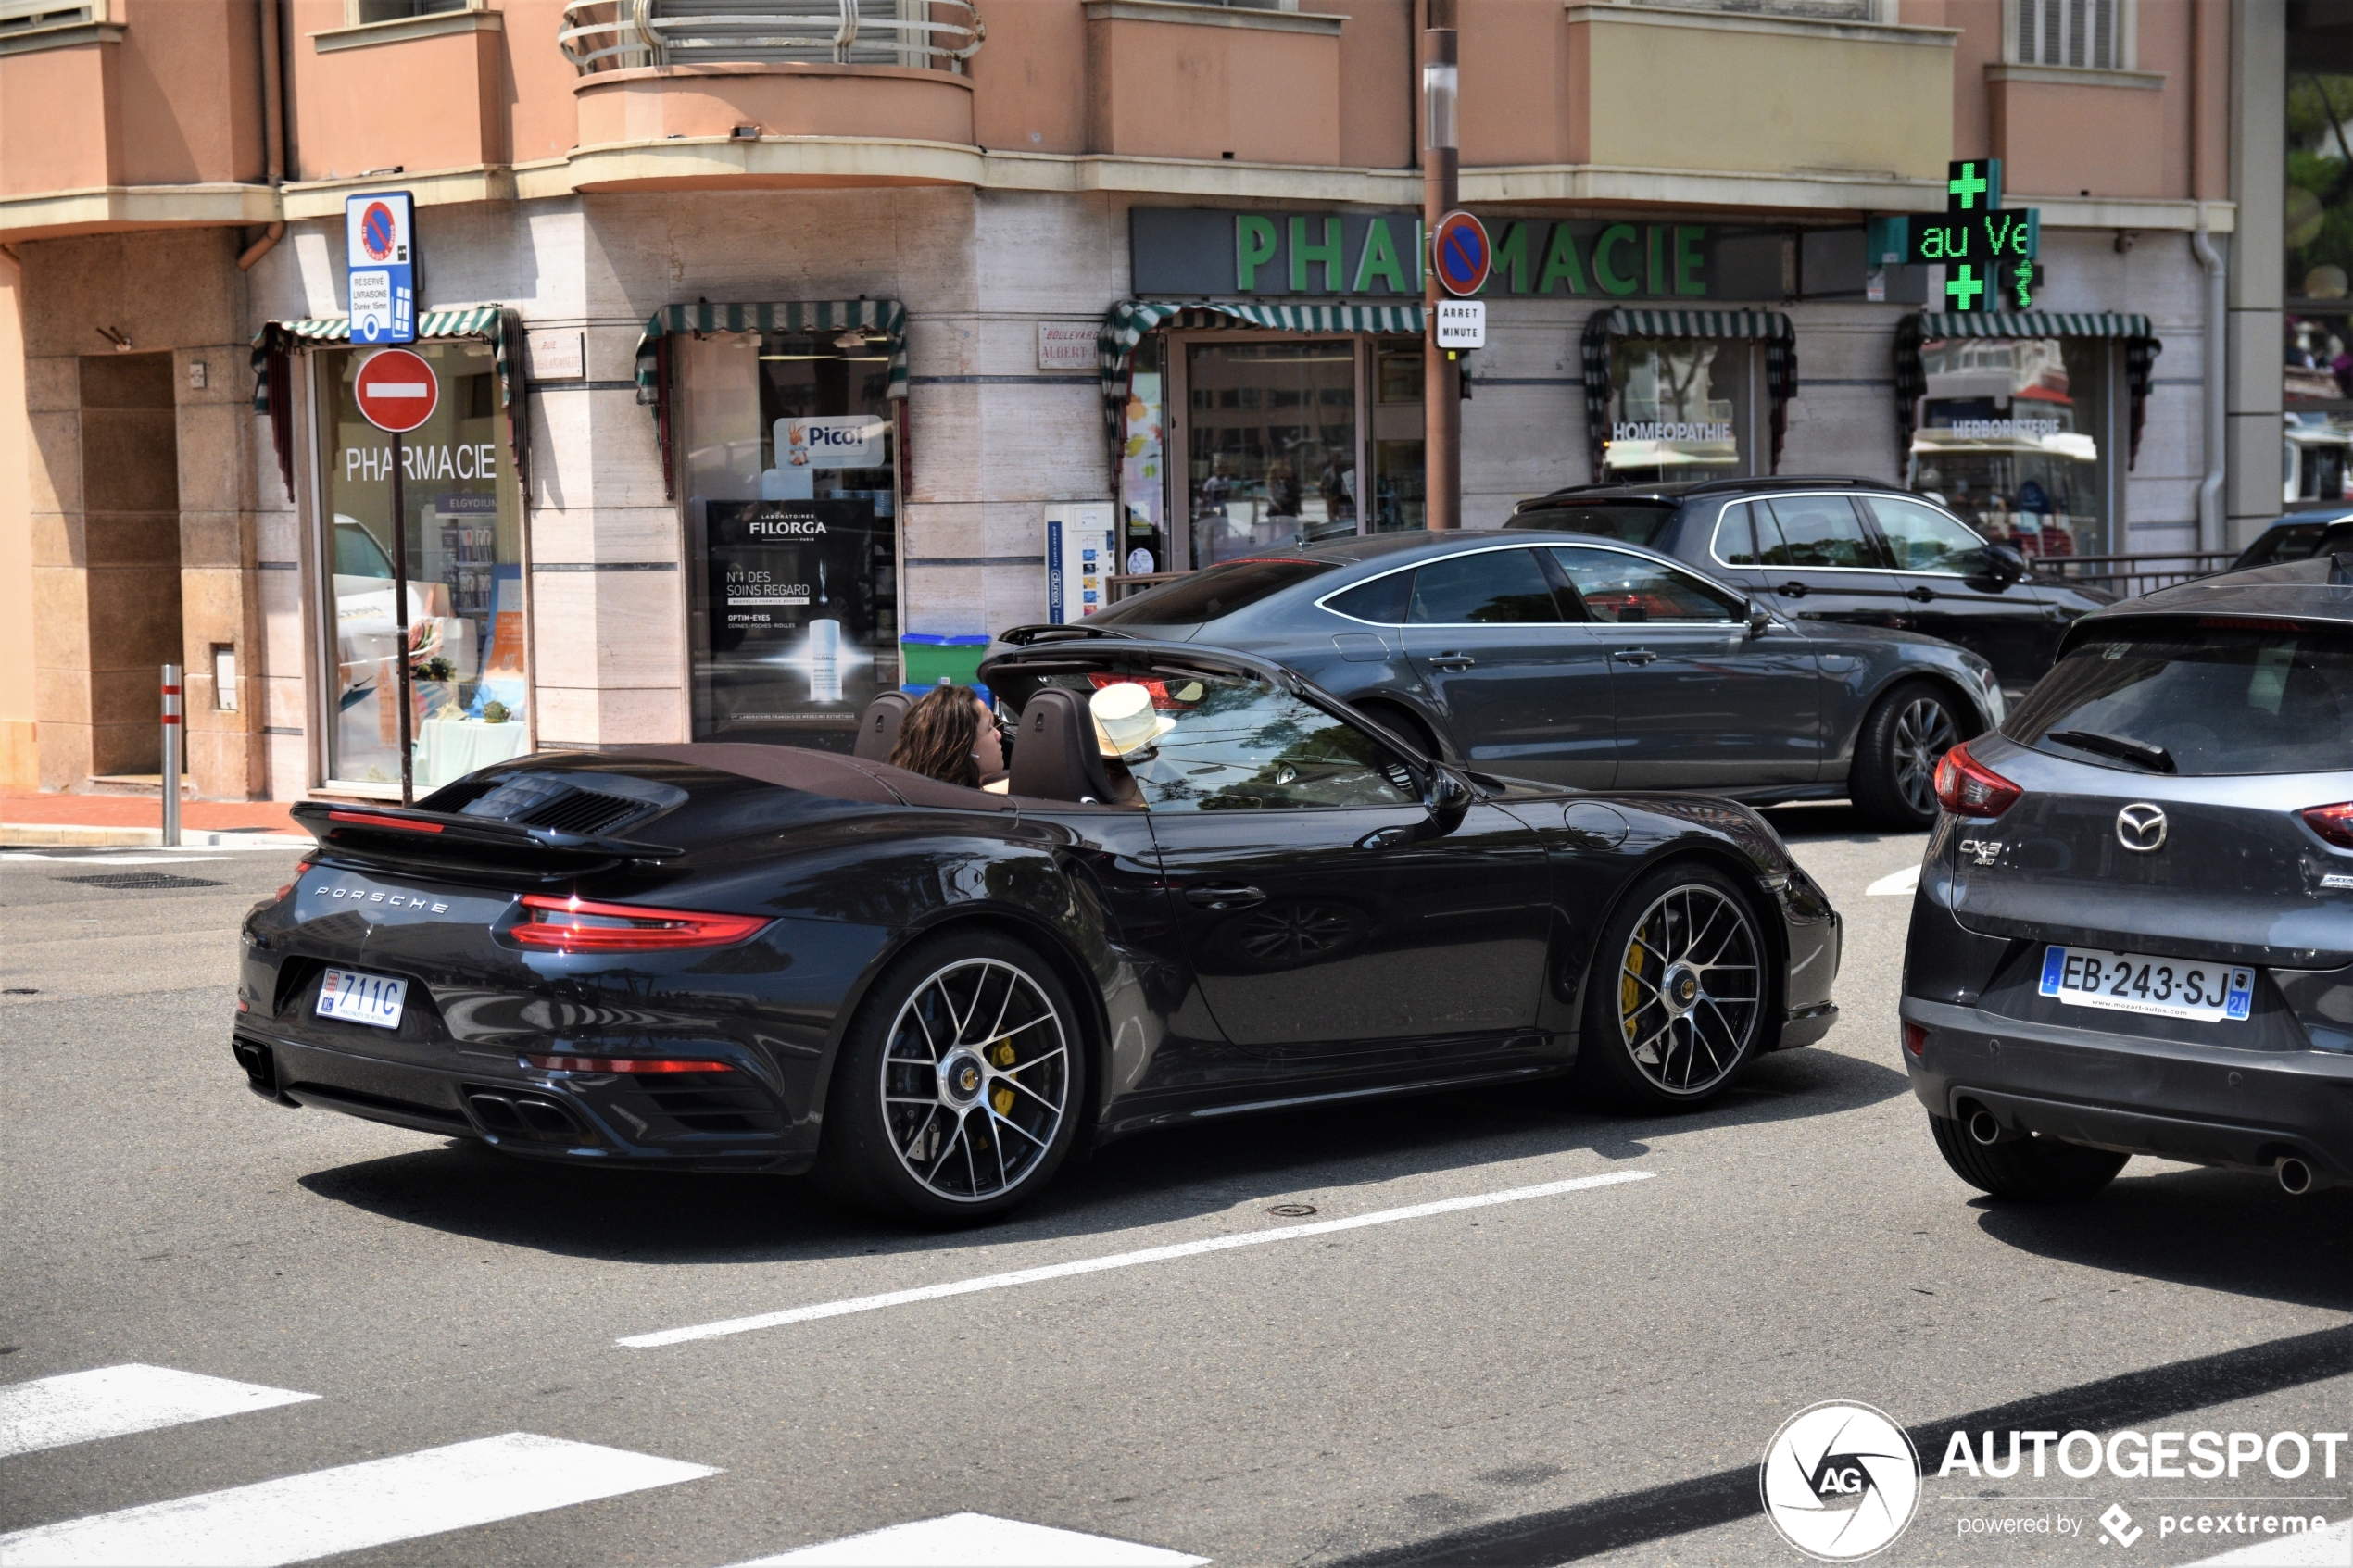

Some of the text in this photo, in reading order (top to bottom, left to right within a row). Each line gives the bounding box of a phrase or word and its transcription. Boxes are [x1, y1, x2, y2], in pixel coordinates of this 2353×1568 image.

[1920, 227, 1968, 257] au
[1236, 214, 1706, 295] PHAMACIE
[353, 290, 388, 299] LIVRAISONS
[1442, 308, 1478, 318] ARRET
[1047, 330, 1100, 340] BOULEVARD
[1442, 328, 1478, 337] MINUTE
[542, 341, 557, 350] RUE
[1041, 346, 1087, 358] ALBERT
[809, 426, 864, 446] Picot
[1613, 421, 1730, 441] HOMEOPATHIE
[1952, 419, 2060, 439] HERBORISTERIE
[346, 445, 497, 482] PHARMACIE
[749, 521, 827, 534] FILORGA
[748, 571, 772, 583] DES
[726, 584, 810, 596] SOINS REGARD
[1959, 839, 2003, 857] CX-3
[1973, 857, 1995, 866] AWD
[315, 886, 449, 914] PORSCHE
[2047, 955, 2246, 1015] F EB-243-SJ 2A
[323, 974, 398, 1015] MC 711C
[2092, 999, 2188, 1016] www.mozart-autos.com
